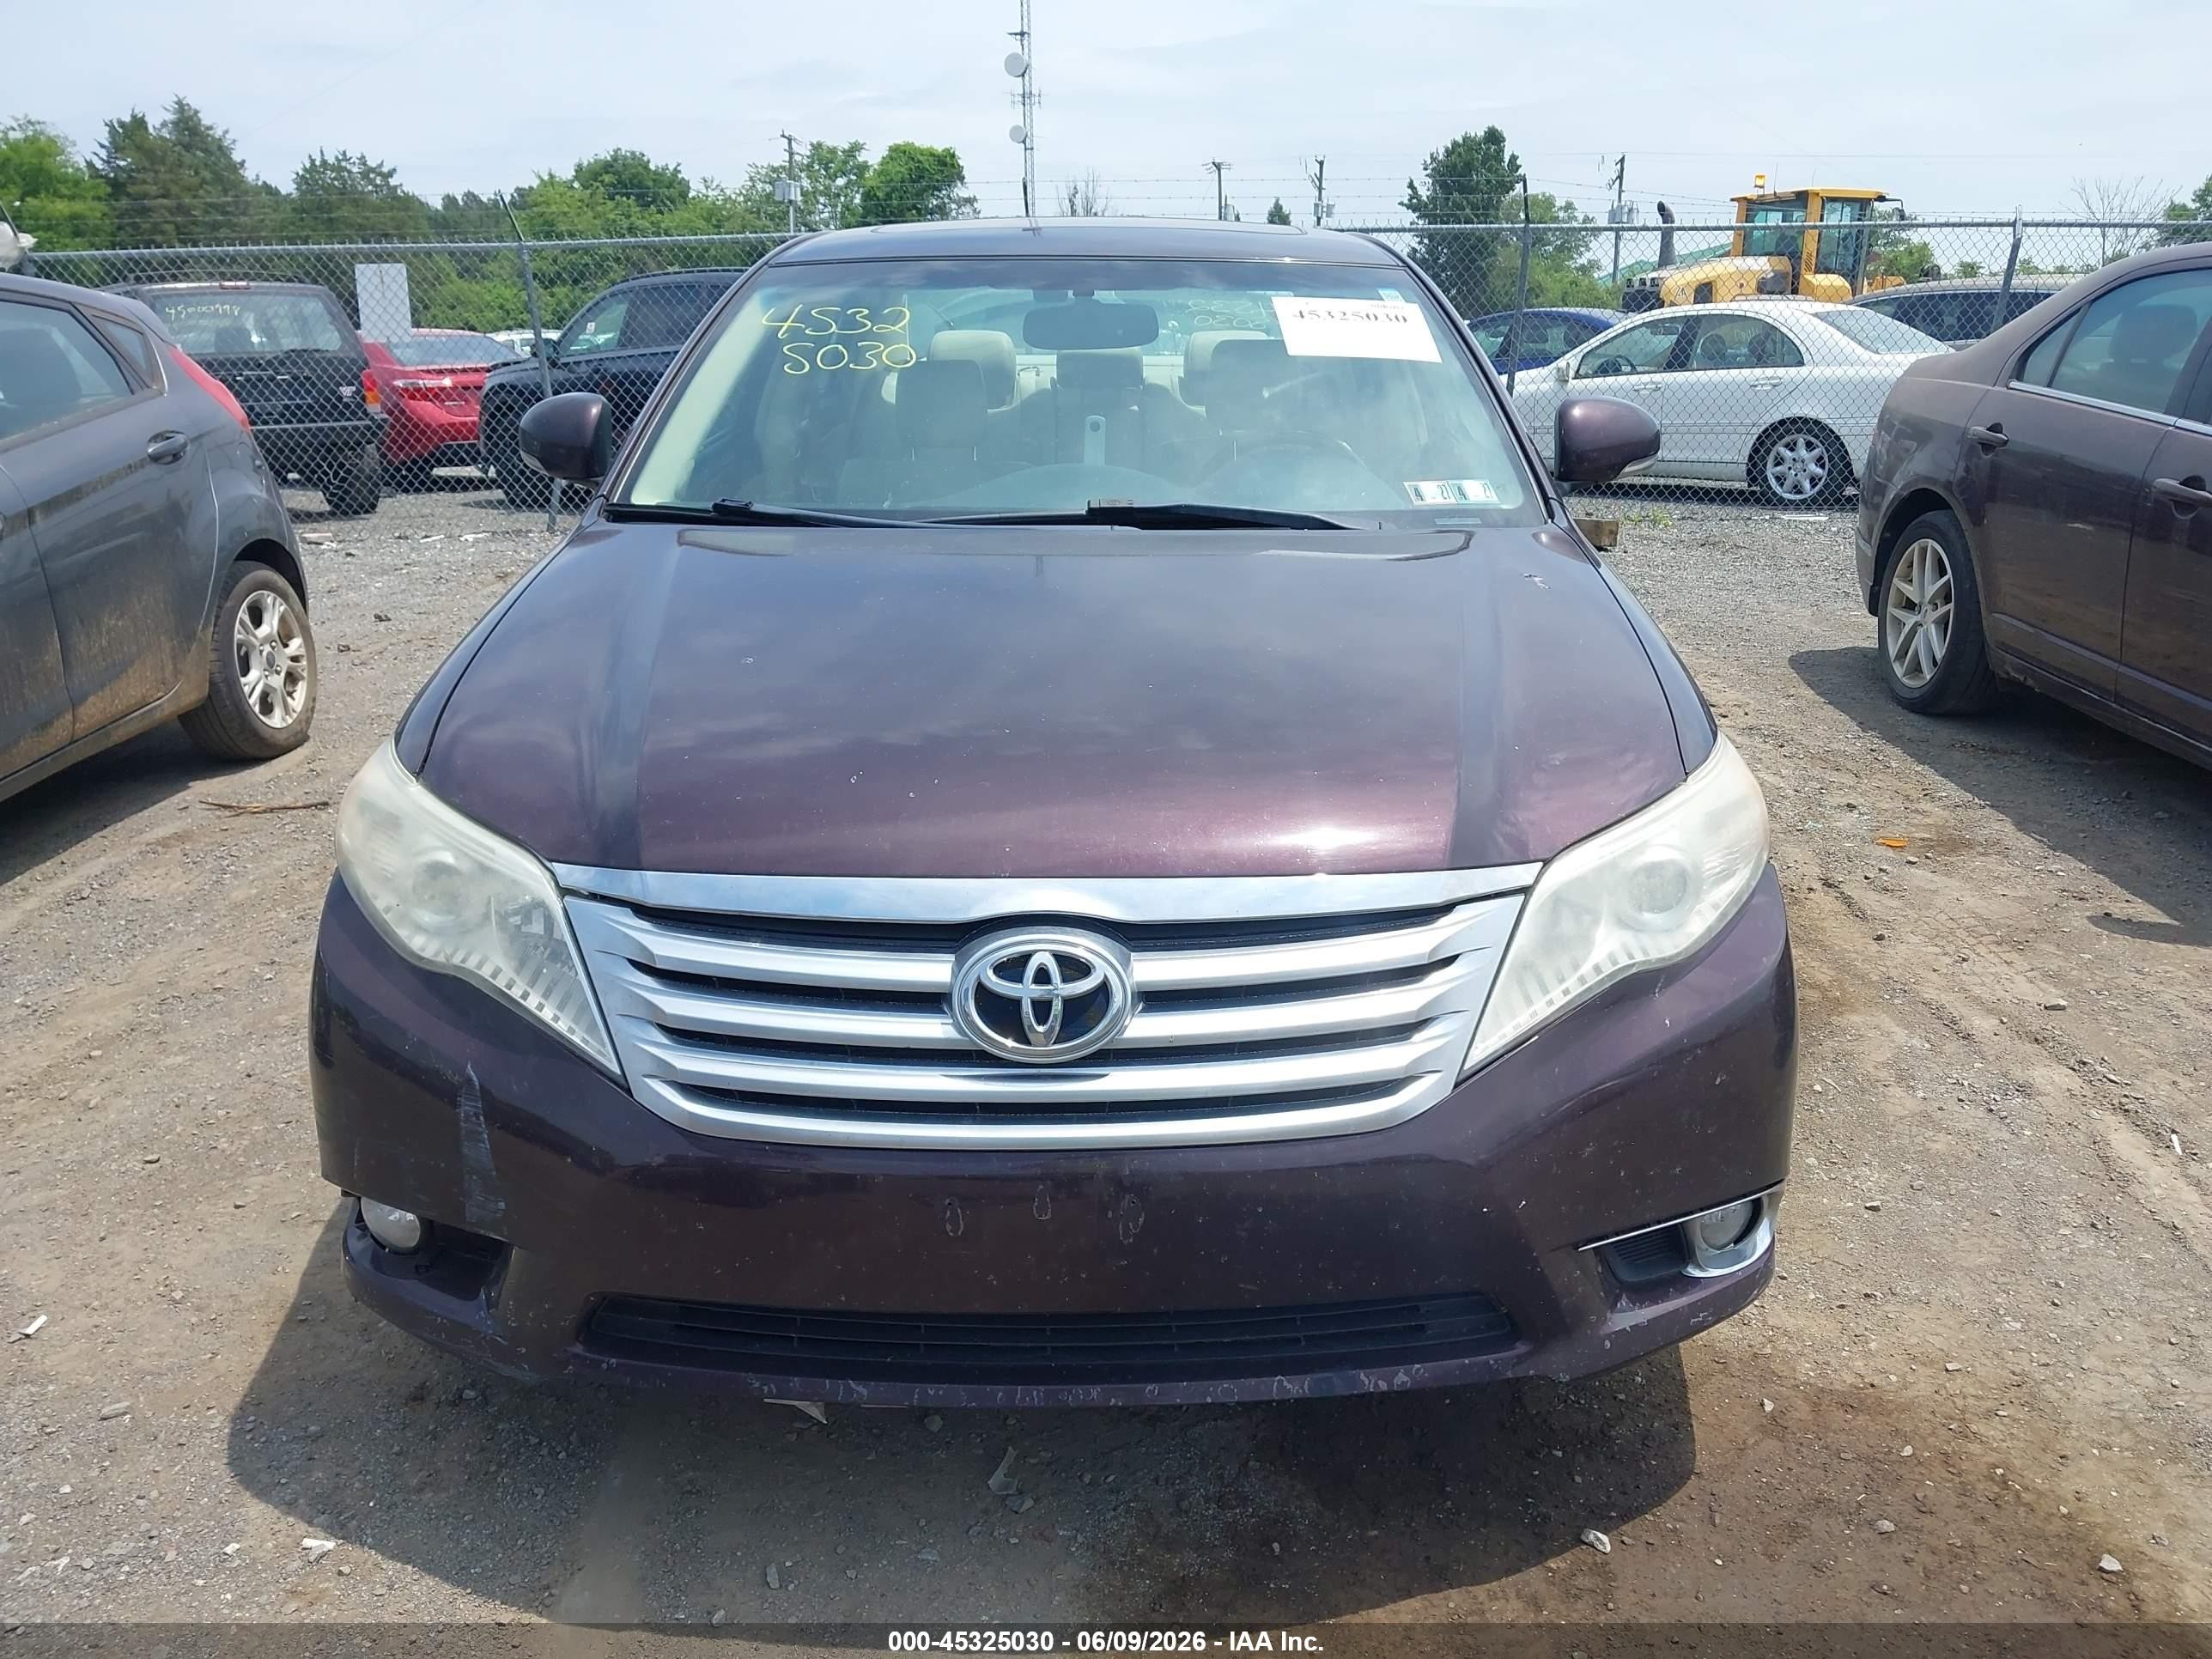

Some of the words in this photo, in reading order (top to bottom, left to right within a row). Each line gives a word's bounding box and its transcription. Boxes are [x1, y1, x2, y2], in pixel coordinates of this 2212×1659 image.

[762, 304, 910, 338] 4532
[1293, 309, 1407, 323] 45325030
[783, 341, 916, 374] 5030
